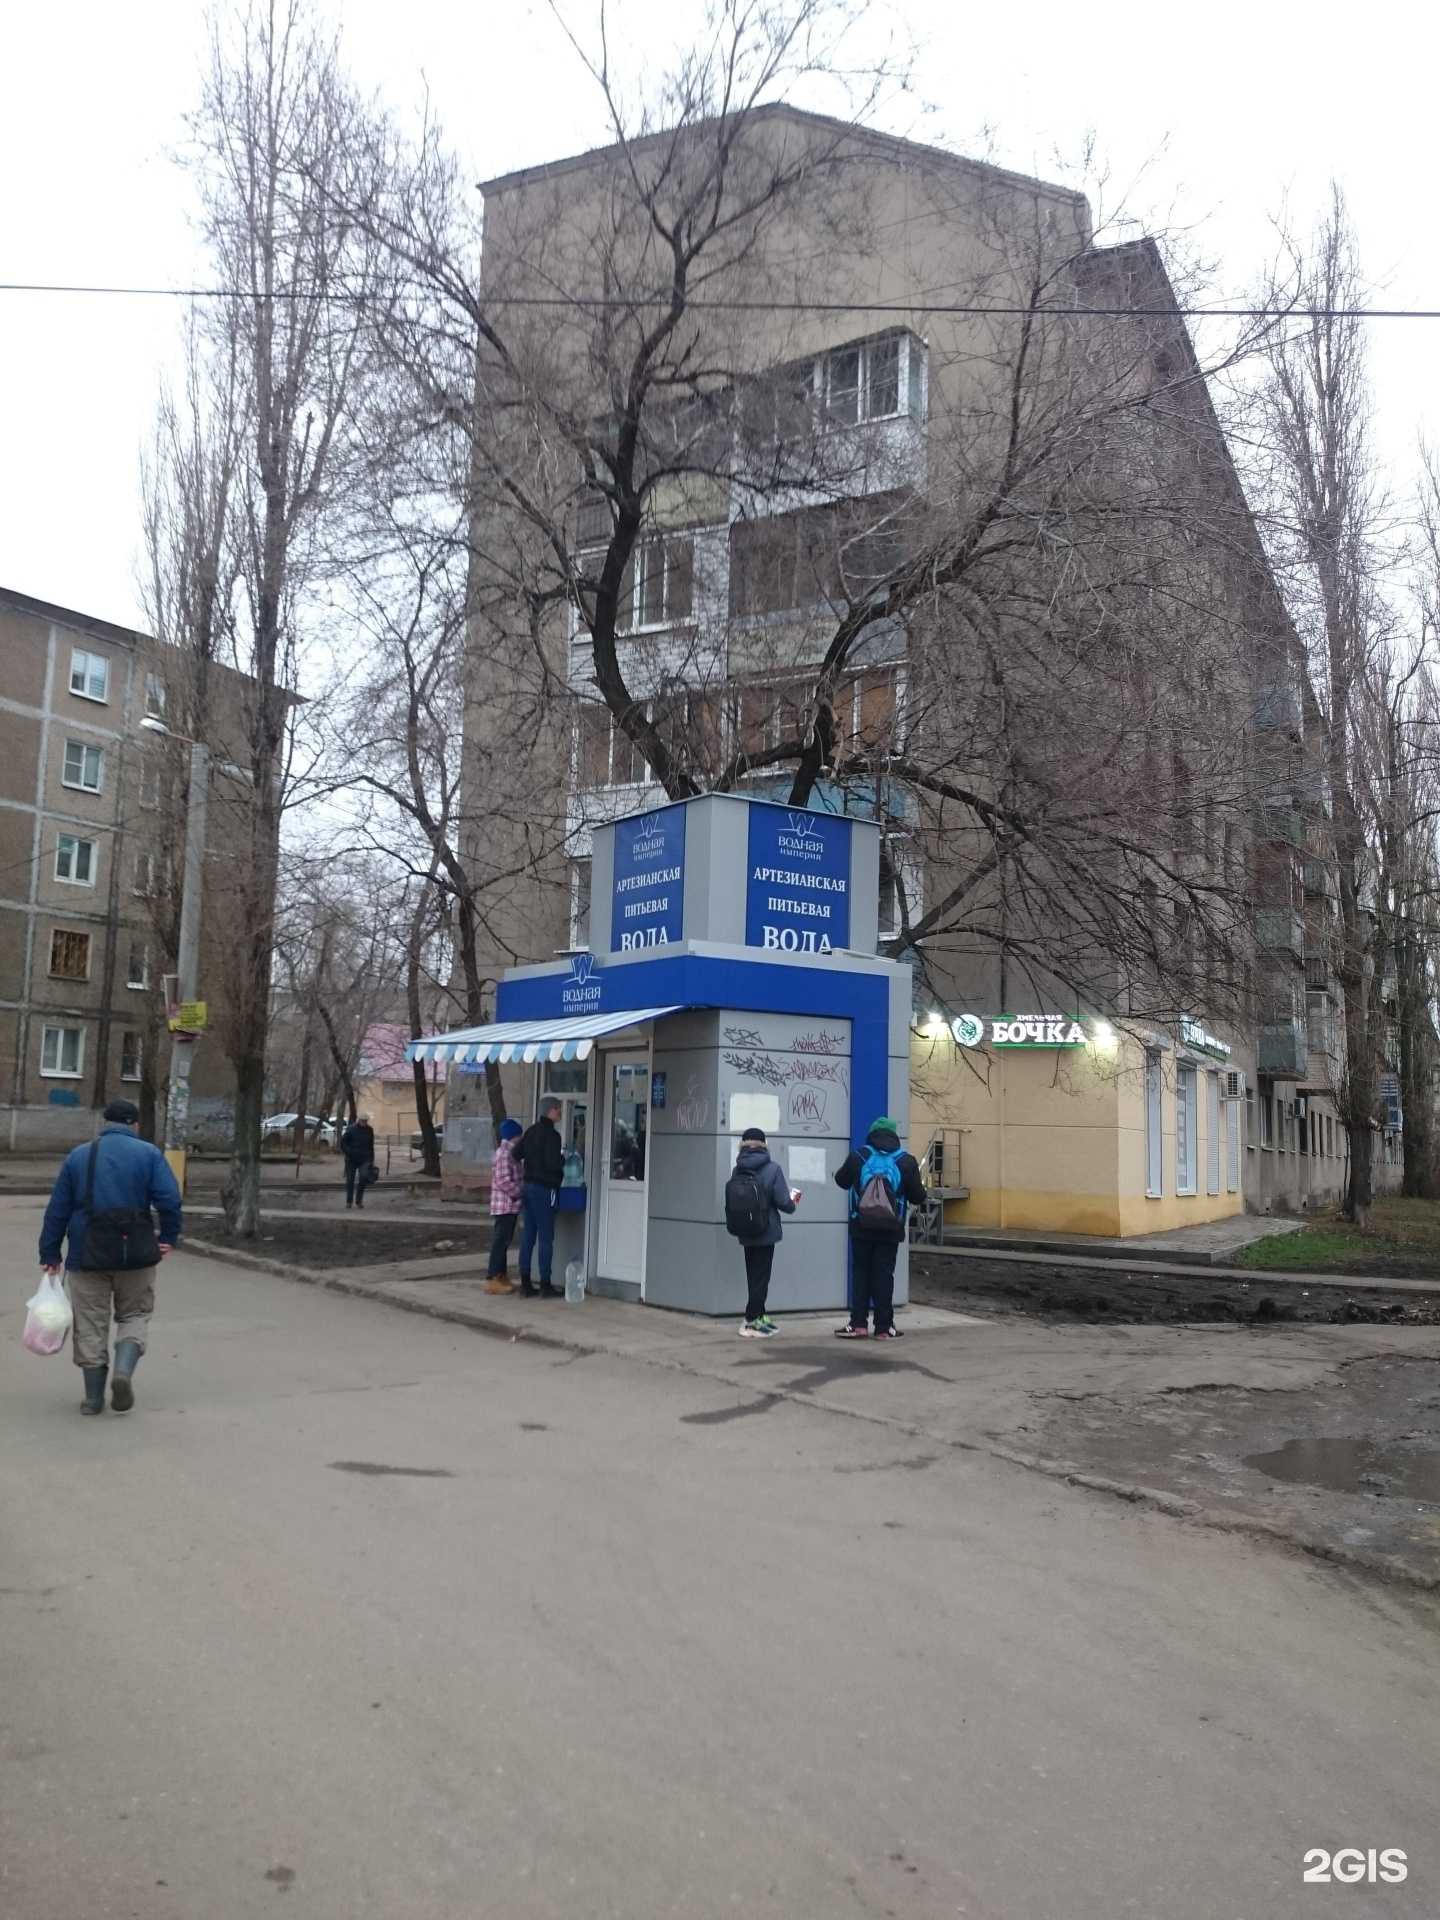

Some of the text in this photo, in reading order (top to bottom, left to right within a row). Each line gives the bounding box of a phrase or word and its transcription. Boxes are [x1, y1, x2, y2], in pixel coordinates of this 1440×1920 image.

[616, 866, 681, 893] АРТЕЗИАНСКАЯ
[753, 867, 846, 892] АРТЕЗИАНСКАЯ
[624, 898, 668, 918] ПИТЬЕВАЯ
[768, 897, 831, 918] ПИТЬЕВАЯ
[620, 925, 669, 952] ВОДА
[762, 925, 832, 953] ВОДА
[991, 1022, 1088, 1043] БОЧКА
